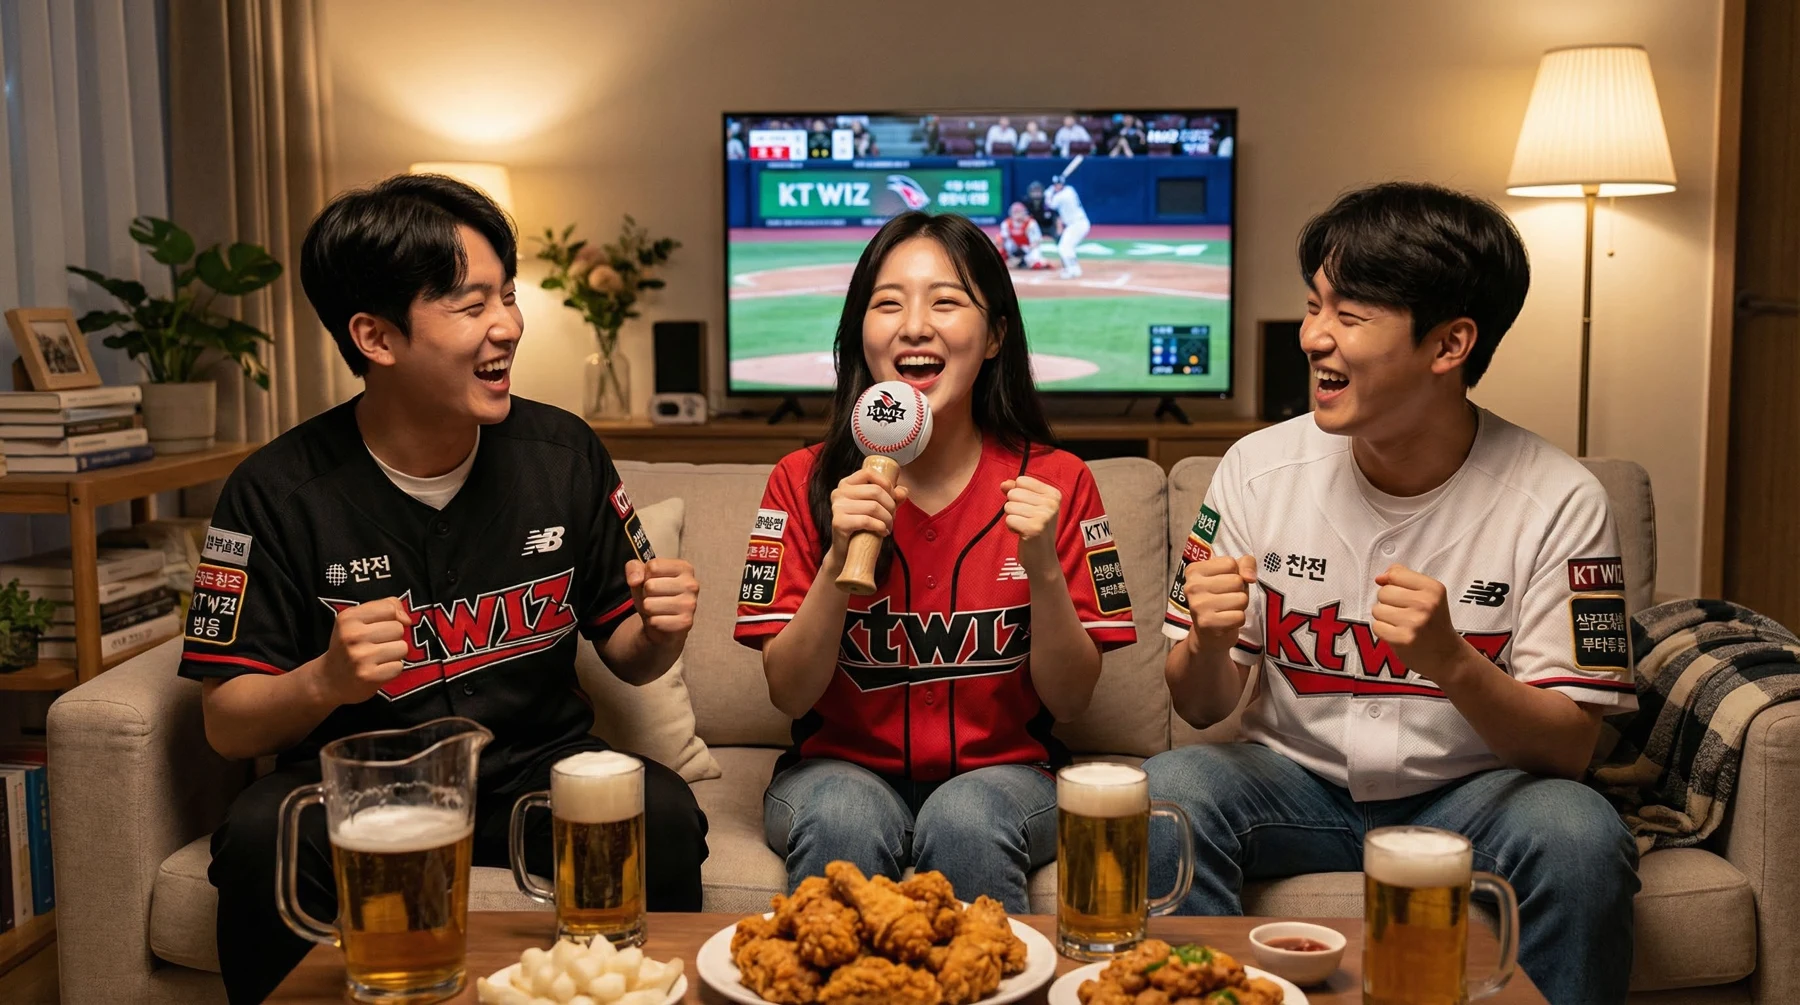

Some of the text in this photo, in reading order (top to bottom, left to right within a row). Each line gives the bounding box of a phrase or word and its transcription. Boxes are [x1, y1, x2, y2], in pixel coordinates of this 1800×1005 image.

[778, 182, 870, 206] KT WIZ
[521, 526, 566, 556] NB
[350, 555, 392, 583] 찬전
[1286, 553, 1327, 582] 찬전
[1573, 564, 1624, 585] KT WIZ
[1458, 579, 1510, 608] NB
